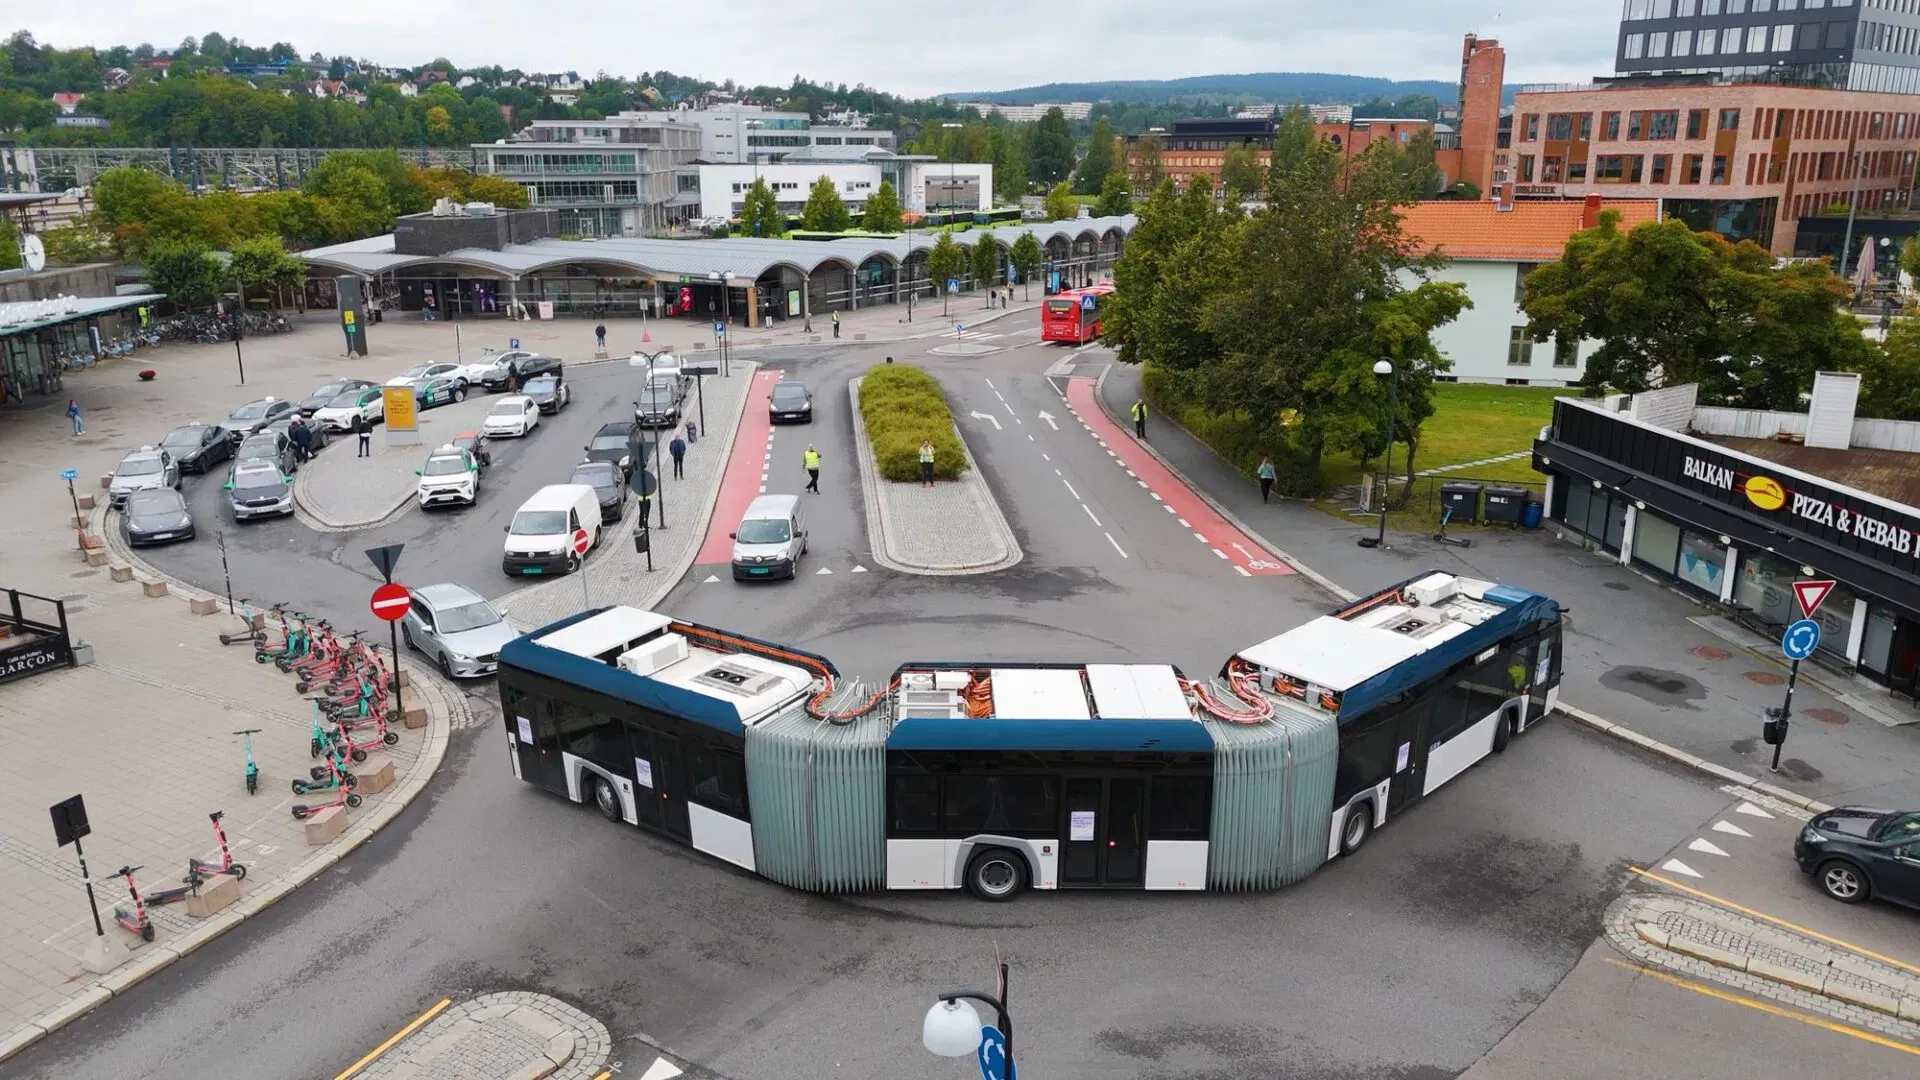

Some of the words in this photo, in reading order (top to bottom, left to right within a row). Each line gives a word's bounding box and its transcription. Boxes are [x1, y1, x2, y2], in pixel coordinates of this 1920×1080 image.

[1683, 456, 1734, 491] BALKAN
[1791, 493, 1833, 528] PIZZA
[1836, 509, 1851, 533] &
[1853, 514, 1911, 554] KEBAB
[0, 651, 55, 676] GARÇON
